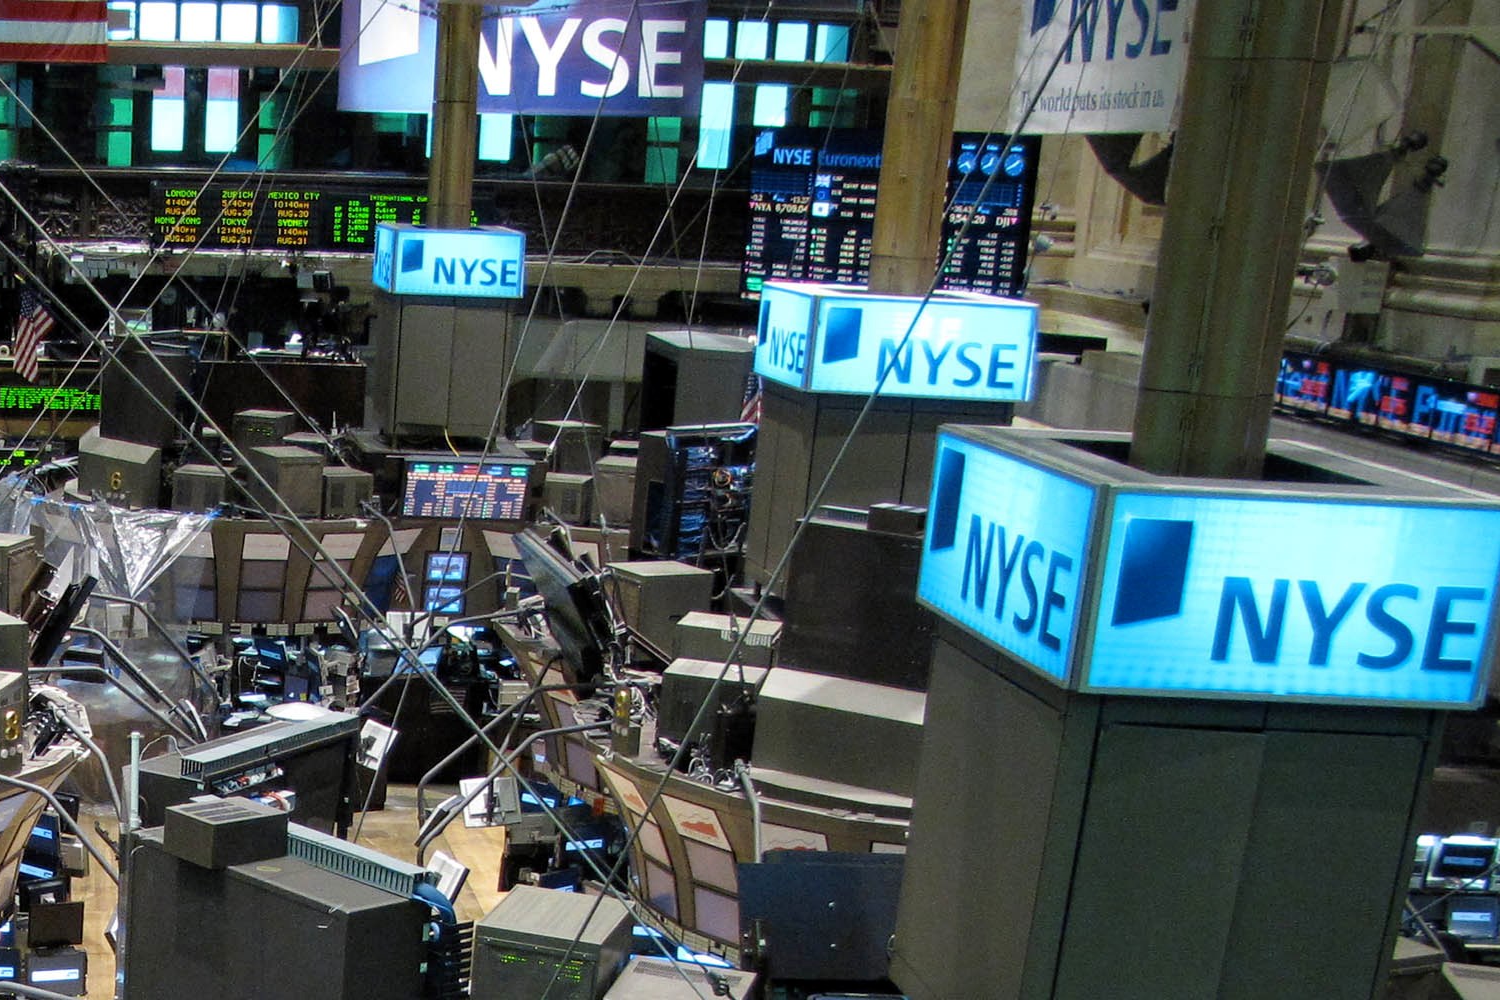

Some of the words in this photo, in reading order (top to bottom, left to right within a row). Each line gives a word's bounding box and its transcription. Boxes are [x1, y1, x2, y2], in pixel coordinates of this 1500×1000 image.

[1064, 0, 1179, 64] NYSE
[1040, 87, 1072, 112] world
[1099, 86, 1112, 110] its
[1112, 82, 1139, 109] stock
[1140, 83, 1151, 108] in
[773, 148, 812, 165] NYSE
[818, 150, 883, 168] Euronext
[165, 190, 197, 198] LONDON
[222, 190, 253, 199] ZURICH
[268, 191, 301, 199] MEXICO
[274, 201, 310, 209] 10:40AM
[754, 202, 772, 212] NYA
[277, 210, 309, 218] AUG.30
[222, 218, 247, 226] TOKYO
[277, 218, 309, 227] SYDNEY
[995, 216, 1010, 228] DJI
[278, 228, 309, 236] 1:40AM
[220, 236, 251, 244] AUG.31
[277, 237, 307, 245] AUG.31
[434, 257, 517, 287] NYSE
[768, 326, 806, 374] NYSE
[875, 337, 1018, 389] NYSE
[111, 471, 121, 490] 6
[961, 513, 1073, 652] NYSE
[1209, 576, 1486, 673] NYSE
[5, 710, 20, 741] 8
